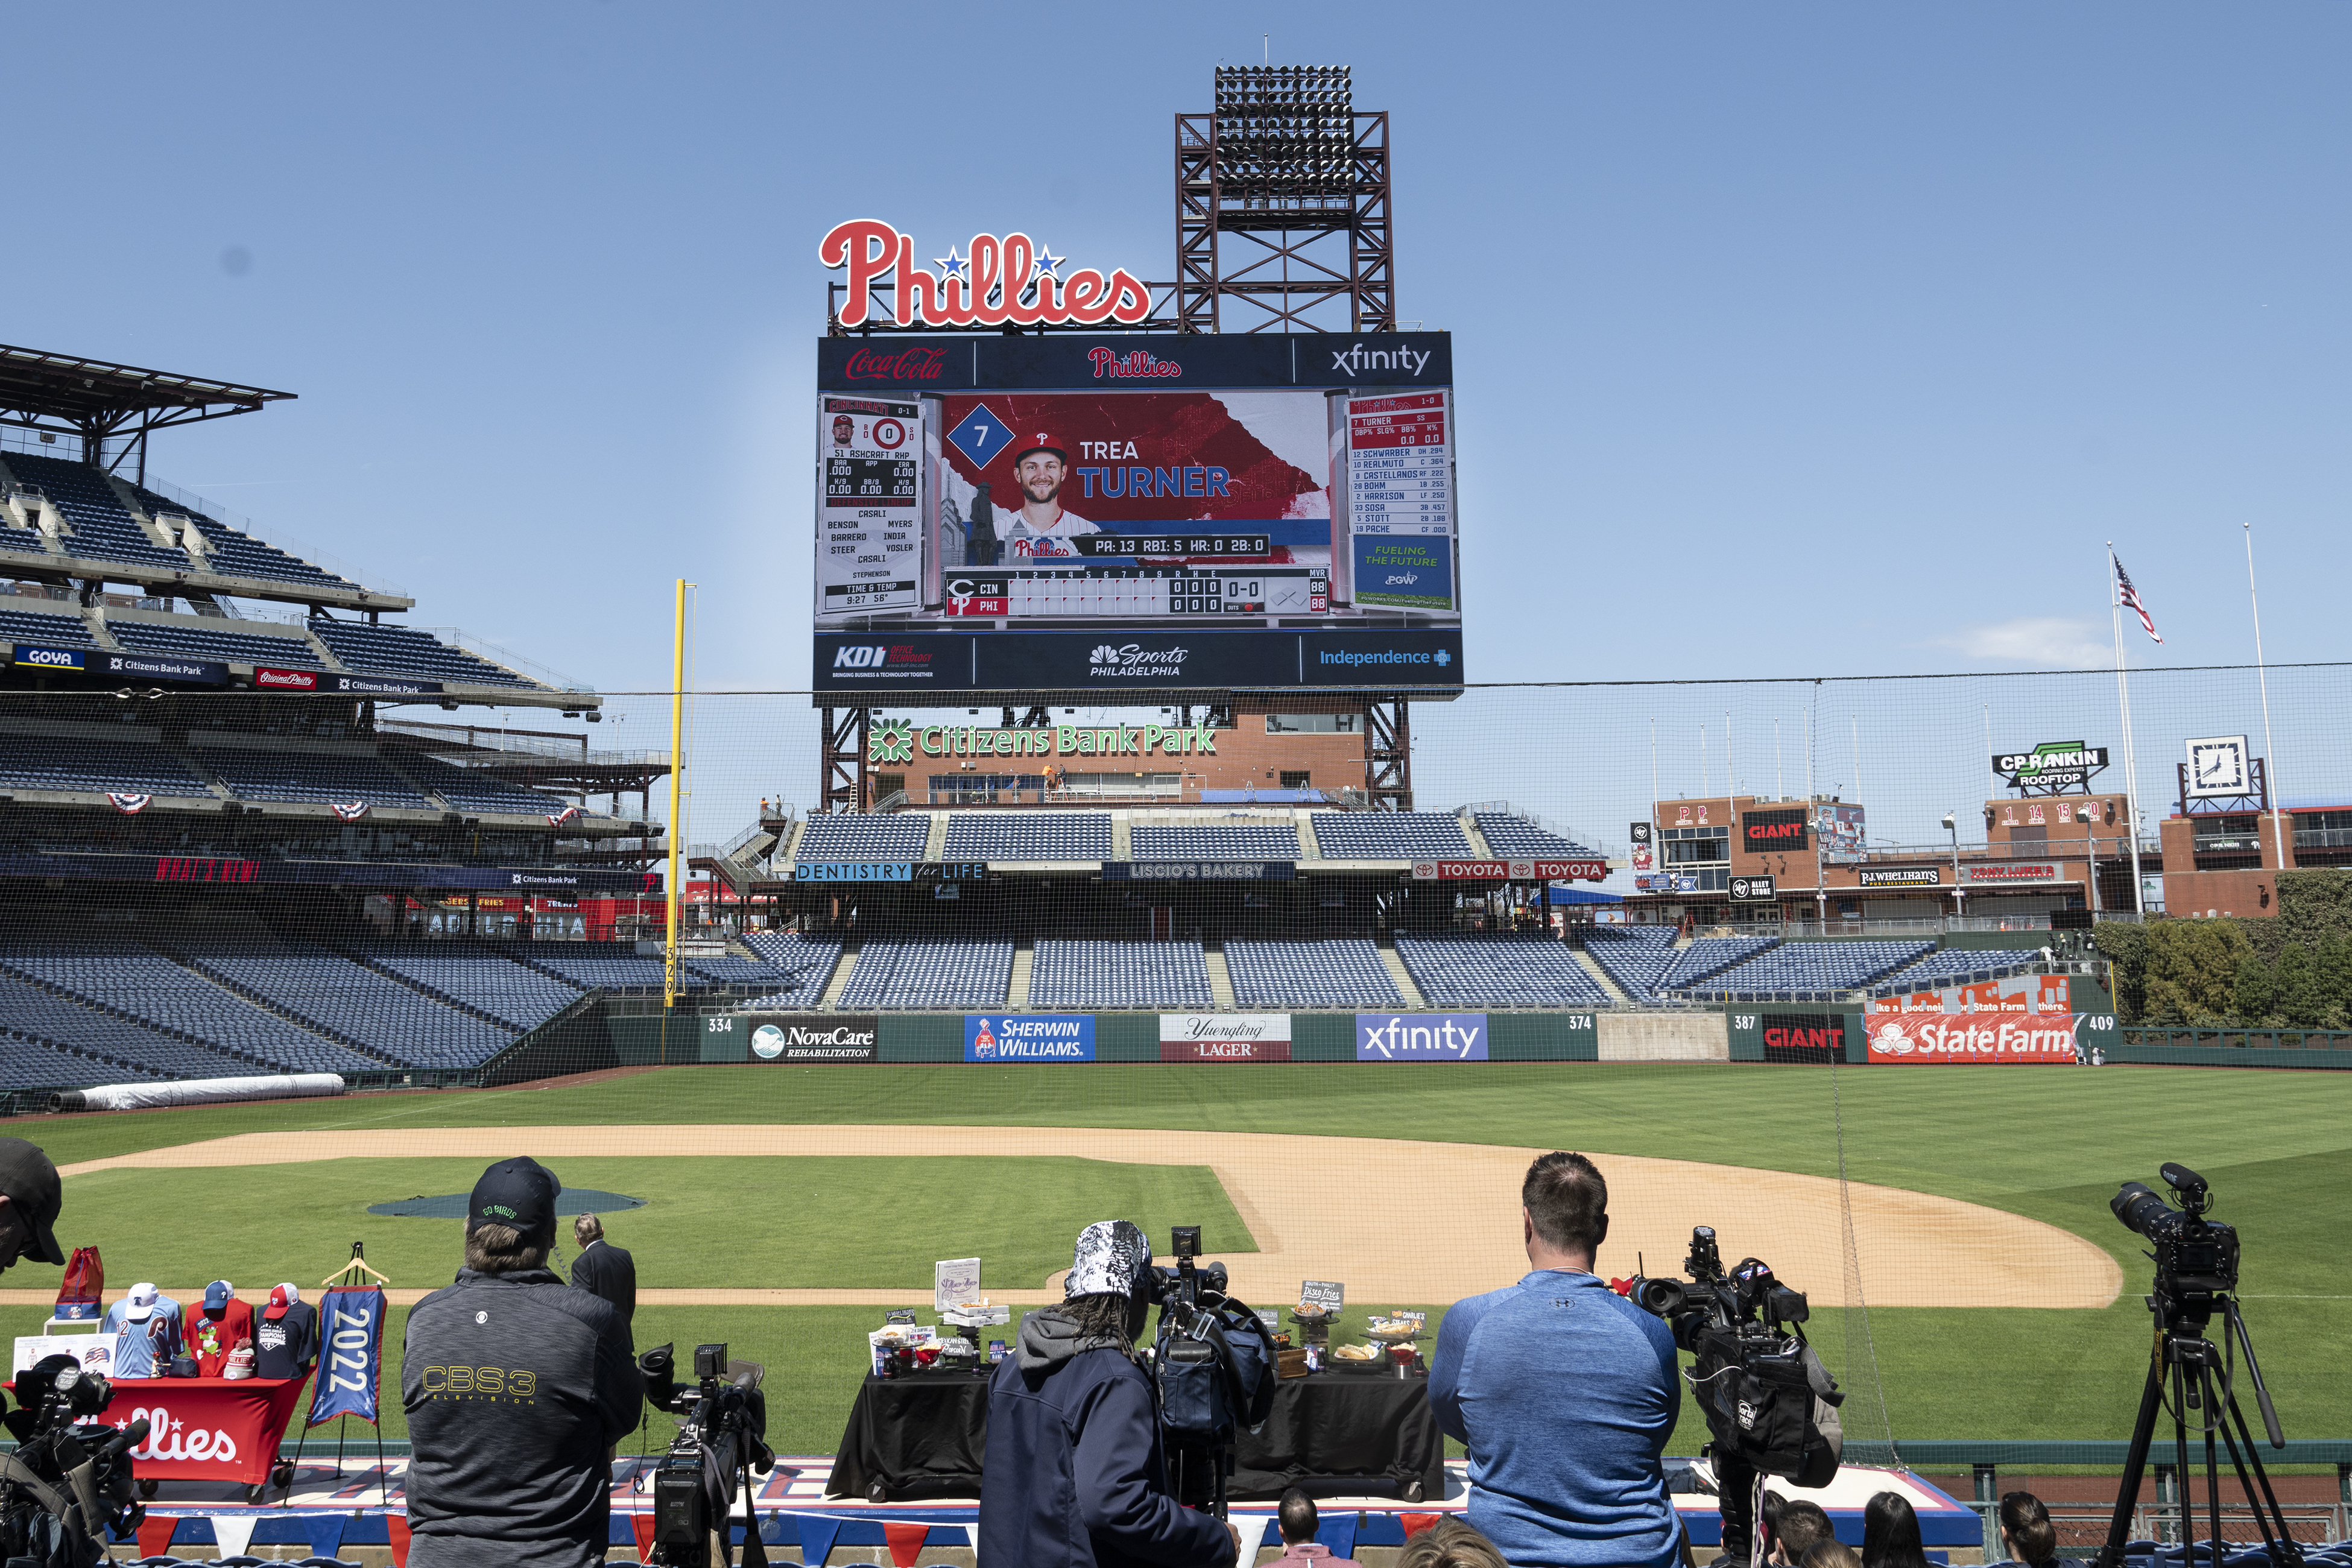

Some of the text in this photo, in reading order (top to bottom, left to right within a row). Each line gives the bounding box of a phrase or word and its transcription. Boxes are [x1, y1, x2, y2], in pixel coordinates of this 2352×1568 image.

[818, 218, 1151, 327] Phillies
[846, 347, 949, 380] Coca-Cola
[1087, 346, 1182, 378] Phillies
[1331, 343, 1431, 376] xfinity
[1421, 396, 1434, 405] 1-0
[829, 399, 889, 416] CINCINNATI
[1362, 417, 1391, 426] TURNER
[974, 426, 990, 447] 7
[850, 450, 890, 459] ASHCRAFT
[1080, 441, 1139, 459] TREA
[1363, 448, 1410, 458] SCHWARBER
[1364, 460, 1404, 469] REALMUTO
[1364, 470, 1418, 479] CASTELLANOS
[1076, 467, 1231, 498] TURNER
[831, 498, 912, 507] DEFENSIVE LINEUP
[1365, 525, 1390, 533] PACHE
[831, 533, 867, 542] BARRERO
[831, 546, 856, 554] STEER
[1015, 539, 1069, 557] Phillies
[1096, 540, 1251, 552] PA: 13 RBI: 5 HR: 2B:
[1375, 546, 1426, 555] FUELING
[858, 555, 886, 563] CASALI
[1365, 556, 1438, 566] THE FUTURE
[1311, 581, 1325, 592] 88
[1388, 575, 1414, 585] PGW
[847, 585, 867, 593] TIME
[877, 583, 897, 591] TEMP
[980, 584, 998, 594] CIN
[1228, 581, 1259, 597] 0-0
[847, 596, 866, 604] 9:27
[980, 601, 998, 611] PHI
[1311, 598, 1325, 609] 88
[891, 645, 914, 654] OFFICE
[28, 650, 72, 666] GOYA
[833, 646, 932, 668] KDI TECHNOLOGY
[1119, 644, 1188, 669] Sports
[1320, 650, 1430, 668] Independence
[125, 660, 202, 675] Citizens Bank Park
[1090, 666, 1180, 676] PHILADELPHIA
[260, 671, 314, 686] Original Philly
[352, 680, 419, 694] Citizens Bank Park
[920, 720, 1216, 754] Citizens Bank Park
[2000, 750, 2098, 770] CP RANKIN
[2020, 774, 2081, 785] ROOFTOP
[2029, 805, 2042, 819] 14
[2056, 803, 2070, 817] 15
[1749, 823, 1801, 839] GIANT
[157, 858, 260, 882] WHAT'S NEW!
[798, 863, 982, 879] DENTISTRY for LIFE
[1130, 864, 1265, 878] LISCIO'S BAKERY
[1442, 864, 1505, 876] TOYOTA
[1539, 864, 1602, 876] TOYOTA
[2008, 865, 2054, 874] LUKE'S
[1751, 887, 1771, 896] STORE
[1974, 1002, 2066, 1012] State Farm there.
[709, 1019, 732, 1032] 334
[1001, 1020, 1080, 1037] SHERWIN
[1184, 1017, 1266, 1041] Yuengling
[1570, 1017, 1592, 1030] 374
[1735, 1016, 1754, 1030] 387
[2089, 1016, 2113, 1031] 409
[786, 1027, 871, 1046] NovaCare
[1364, 1018, 1479, 1058] xfinity
[1764, 1028, 1843, 1047] GIANT
[788, 1049, 870, 1058] REHABILITATION
[1000, 1039, 1080, 1056] WILLIAMS
[1200, 1044, 1251, 1057] LAGER
[482, 1205, 517, 1219] GO BIRDS
[1303, 1287, 1339, 1298] Disco Fries
[116, 1320, 128, 1337] 12
[197, 1317, 210, 1328] 2022
[329, 1308, 371, 1393] 2022
[423, 1394, 534, 1405] TELEVISION
